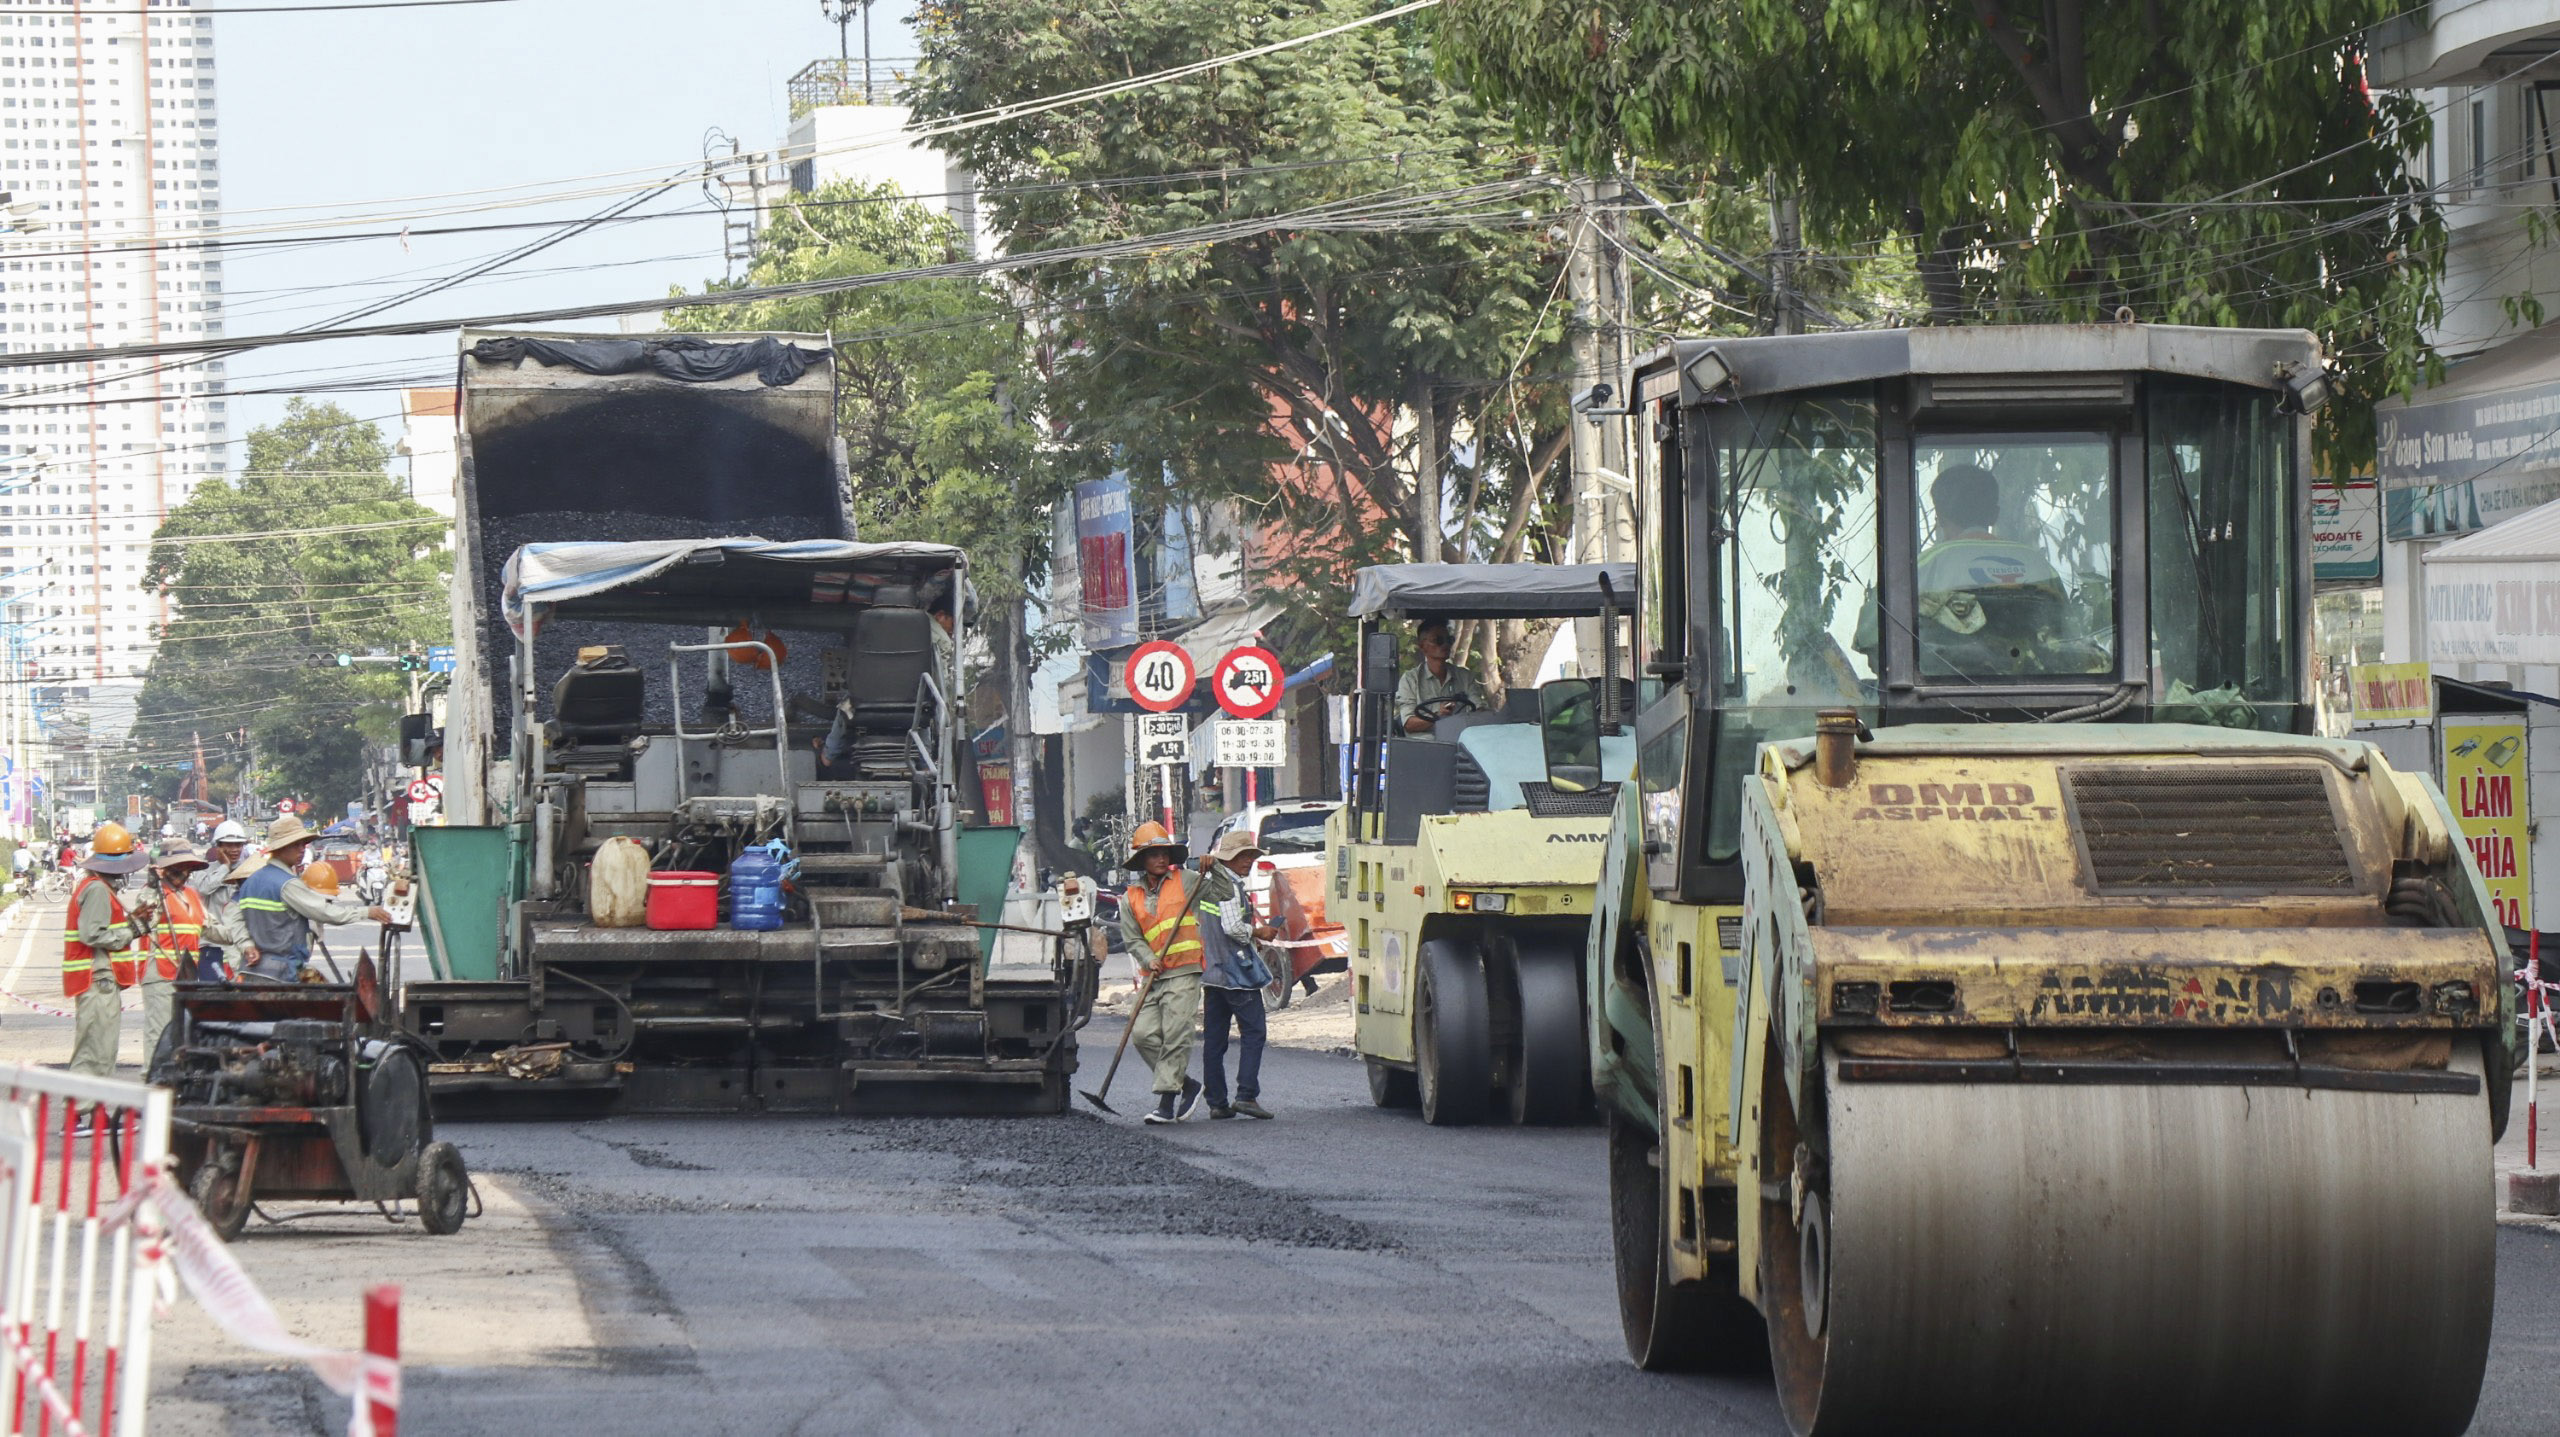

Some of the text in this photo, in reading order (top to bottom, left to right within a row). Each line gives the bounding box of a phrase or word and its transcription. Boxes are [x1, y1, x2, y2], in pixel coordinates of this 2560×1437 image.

[2424, 430, 2444, 464] Sơn
[2446, 430, 2473, 461] Mobile
[2313, 544, 2353, 553] EXCHANGE
[1145, 661, 1174, 691] 40
[1868, 783, 2036, 806] DMD
[2460, 768, 2513, 818] LÀM
[1853, 806, 2057, 822] ASPHALT
[2031, 971, 2293, 1018] AMMANN
